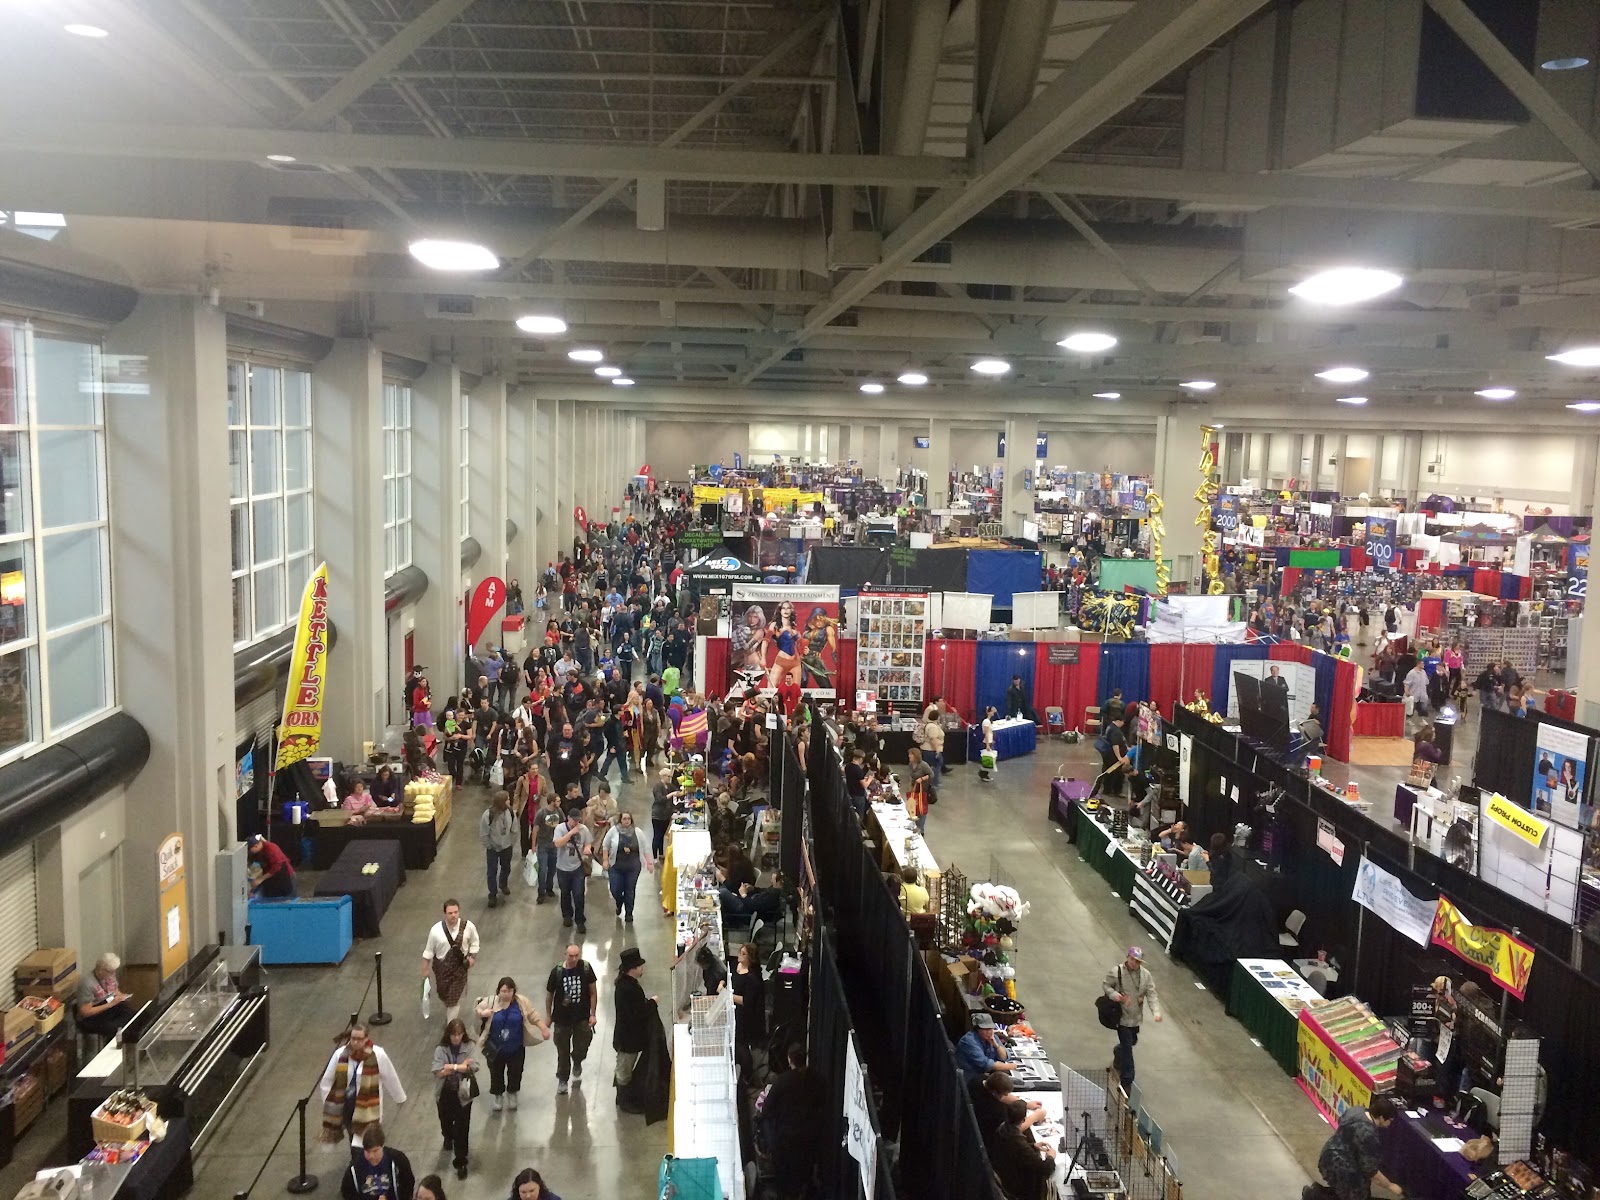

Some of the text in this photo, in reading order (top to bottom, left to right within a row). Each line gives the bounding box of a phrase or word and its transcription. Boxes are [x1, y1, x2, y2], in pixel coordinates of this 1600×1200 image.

[1216, 514, 1236, 527] 2000
[1366, 541, 1392, 559] 2100
[485, 581, 496, 608] ATM
[747, 591, 782, 599] ZENESCOPE
[1568, 576, 1588, 597] 22
[296, 576, 328, 708] KETTLE
[1490, 803, 1539, 838] CUSTOM PROPS
[1412, 1001, 1433, 1010] 300+
